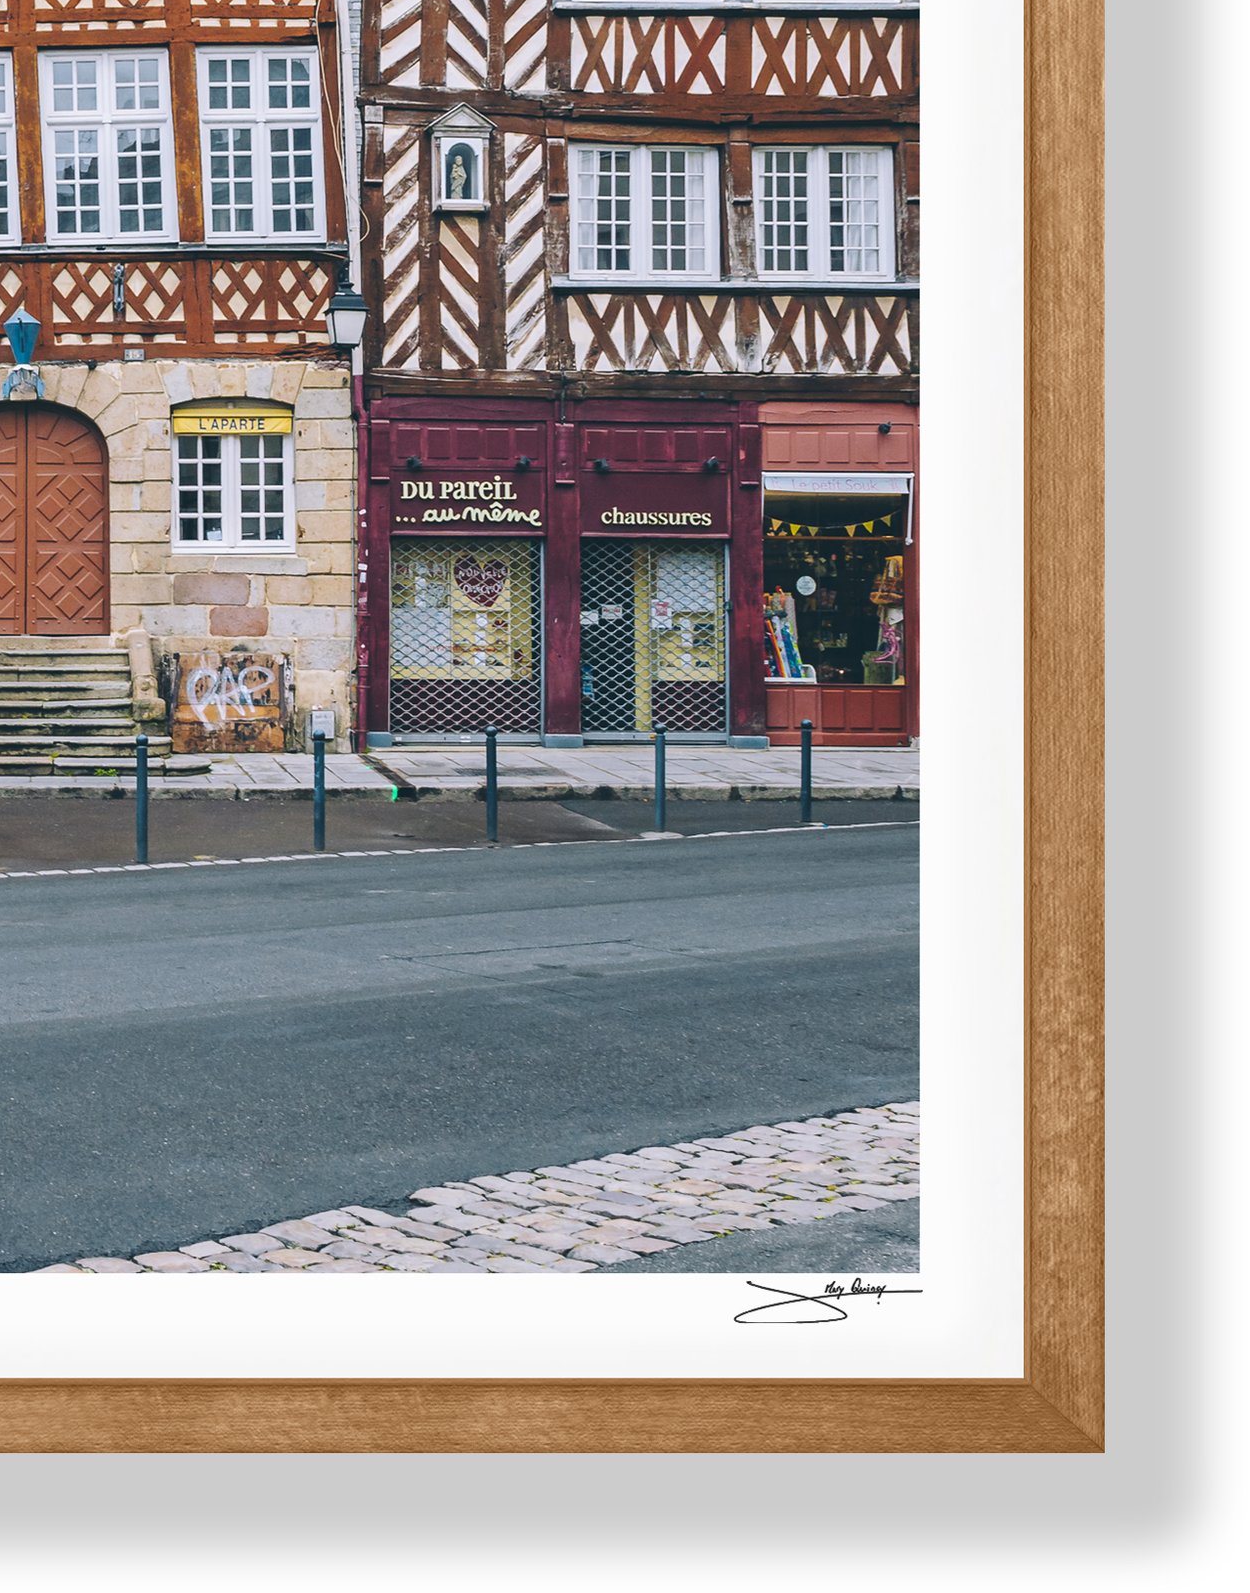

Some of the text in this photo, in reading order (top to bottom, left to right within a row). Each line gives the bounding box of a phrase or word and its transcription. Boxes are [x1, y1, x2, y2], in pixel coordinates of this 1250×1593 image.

[792, 478, 878, 492] Le petit Souk
[461, 501, 543, 527] même
[600, 506, 712, 526] chaussures
